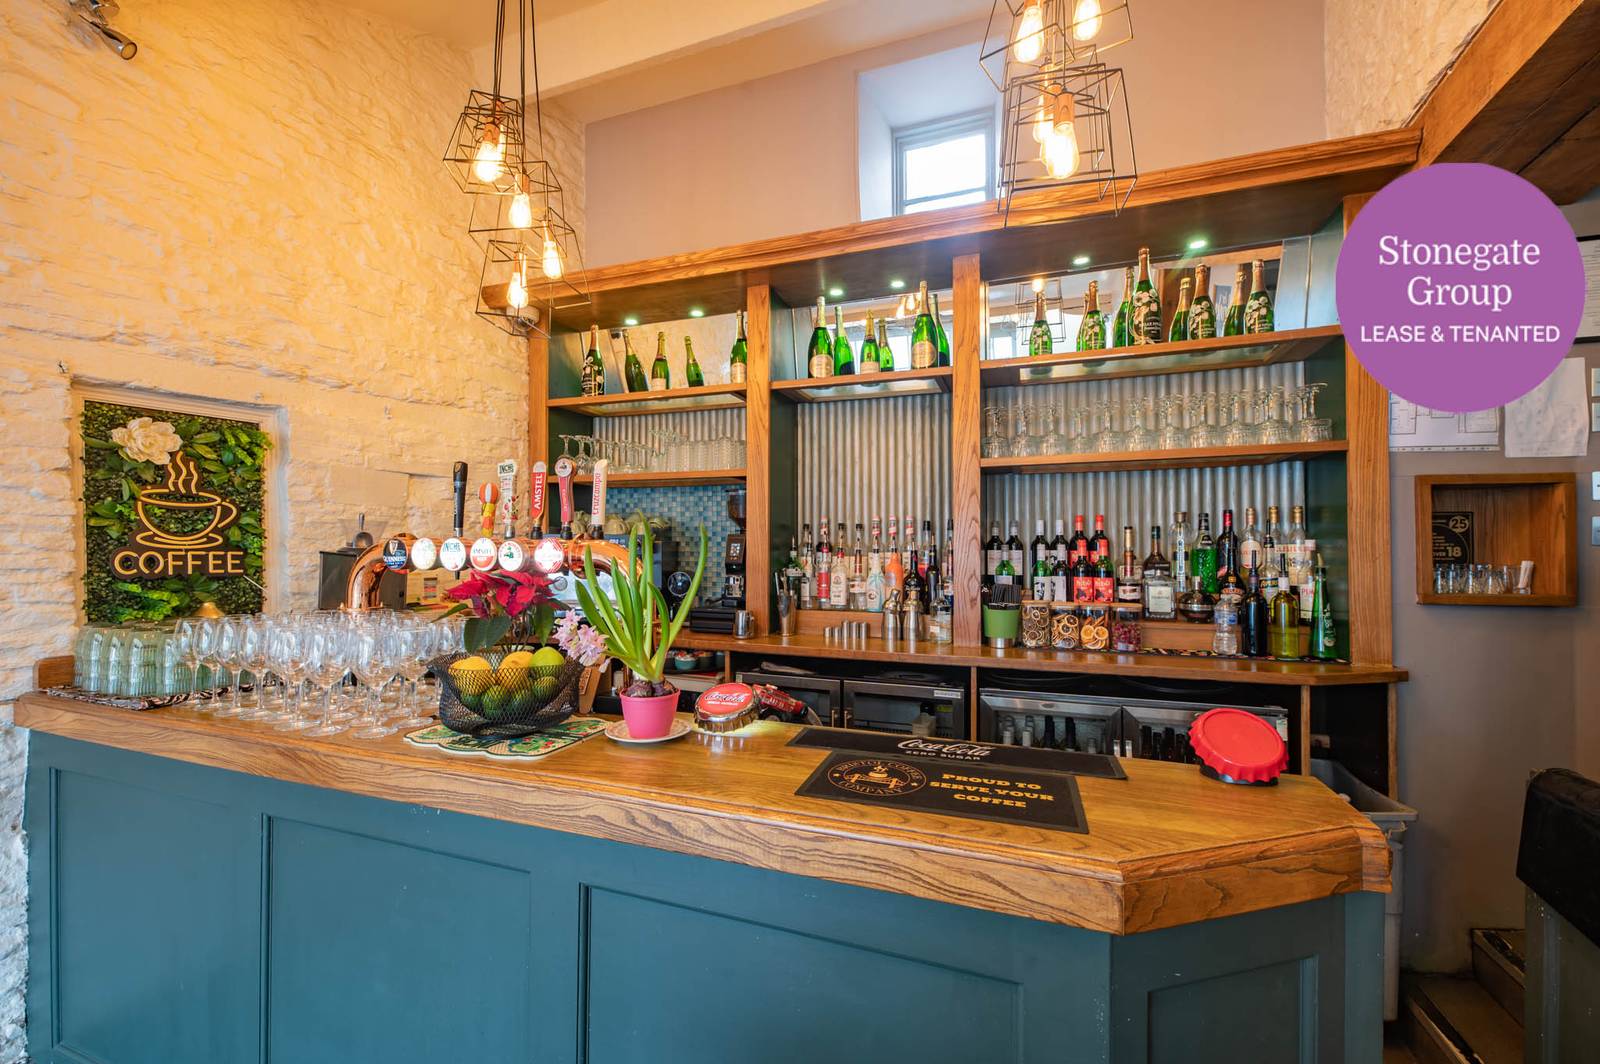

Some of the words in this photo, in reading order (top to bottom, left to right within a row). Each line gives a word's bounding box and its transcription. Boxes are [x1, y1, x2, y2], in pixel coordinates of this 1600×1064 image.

[533, 473, 543, 510] AMSTEL
[1451, 518, 1469, 529] 25
[1446, 546, 1462, 557] 18
[113, 550, 244, 576] COFFEE
[897, 738, 996, 757] Coca-Cola
[939, 752, 981, 761] SUGAR
[941, 773, 1011, 787] PROUD
[1015, 782, 1042, 790] TO
[929, 781, 990, 794] SERVE
[995, 788, 1056, 801] YOUR
[953, 793, 1027, 808] COFFEE
